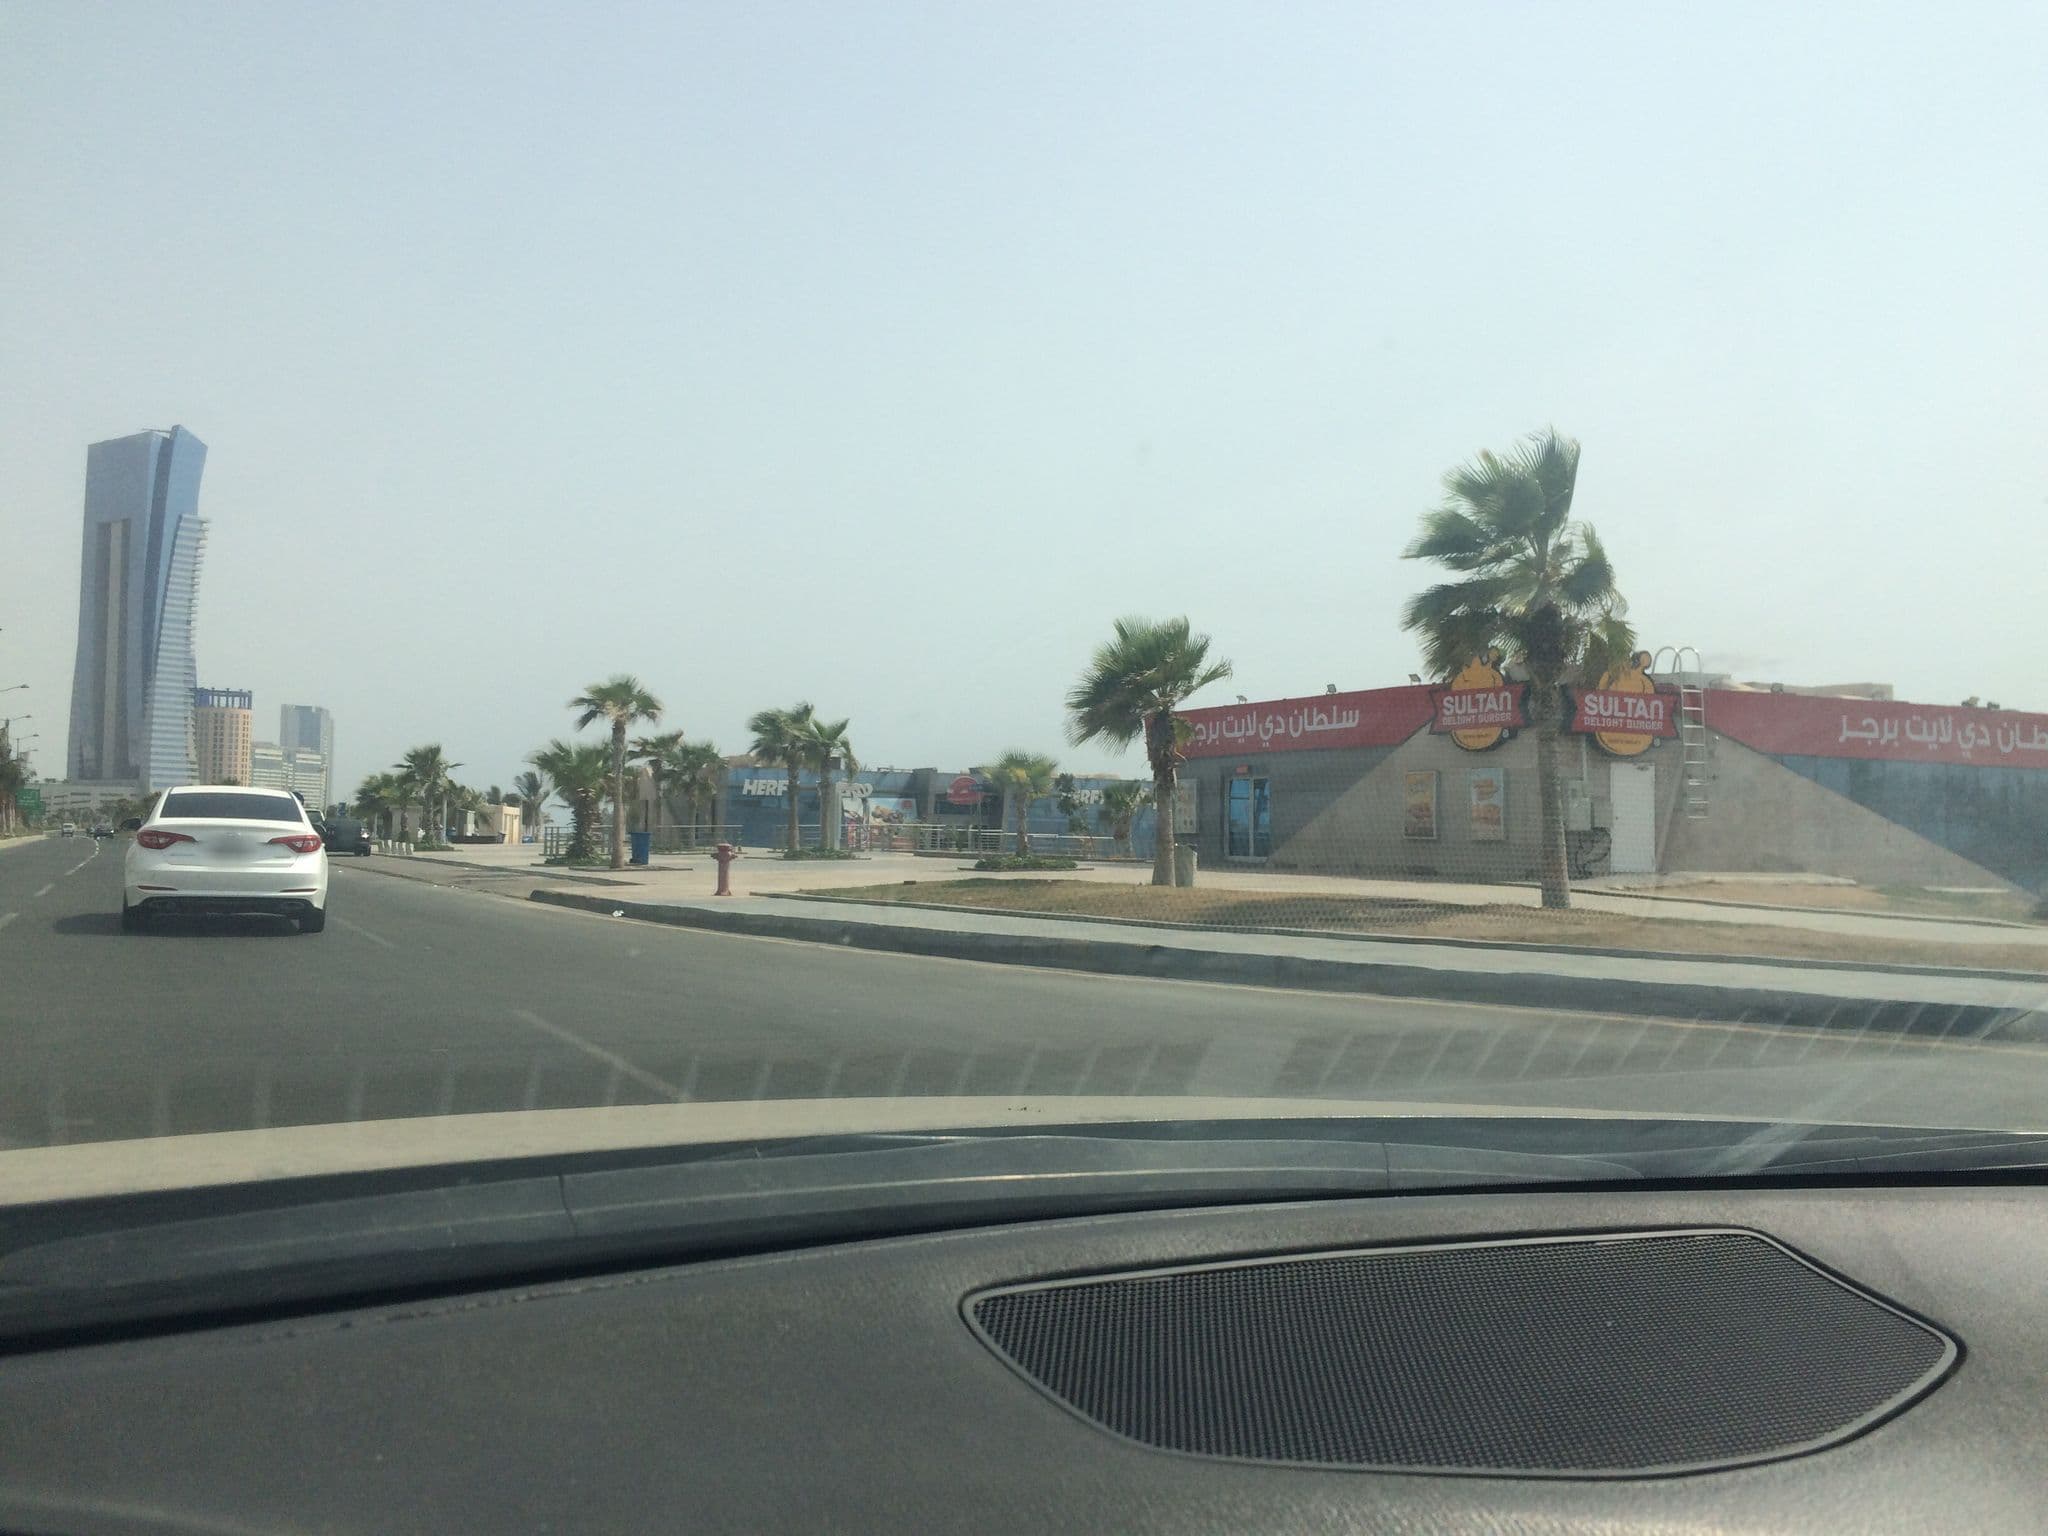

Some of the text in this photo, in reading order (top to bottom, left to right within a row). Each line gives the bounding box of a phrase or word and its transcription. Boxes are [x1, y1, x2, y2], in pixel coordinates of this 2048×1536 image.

[1443, 691, 1512, 715] SULTAN
[1584, 693, 1664, 720] SULTAN
[1186, 706, 1360, 748] سلطان دي لايت برج
[1838, 715, 1900, 747] برجر
[1905, 714, 1952, 750] لايت
[1957, 721, 1991, 760] دي
[742, 779, 789, 796] HERF
